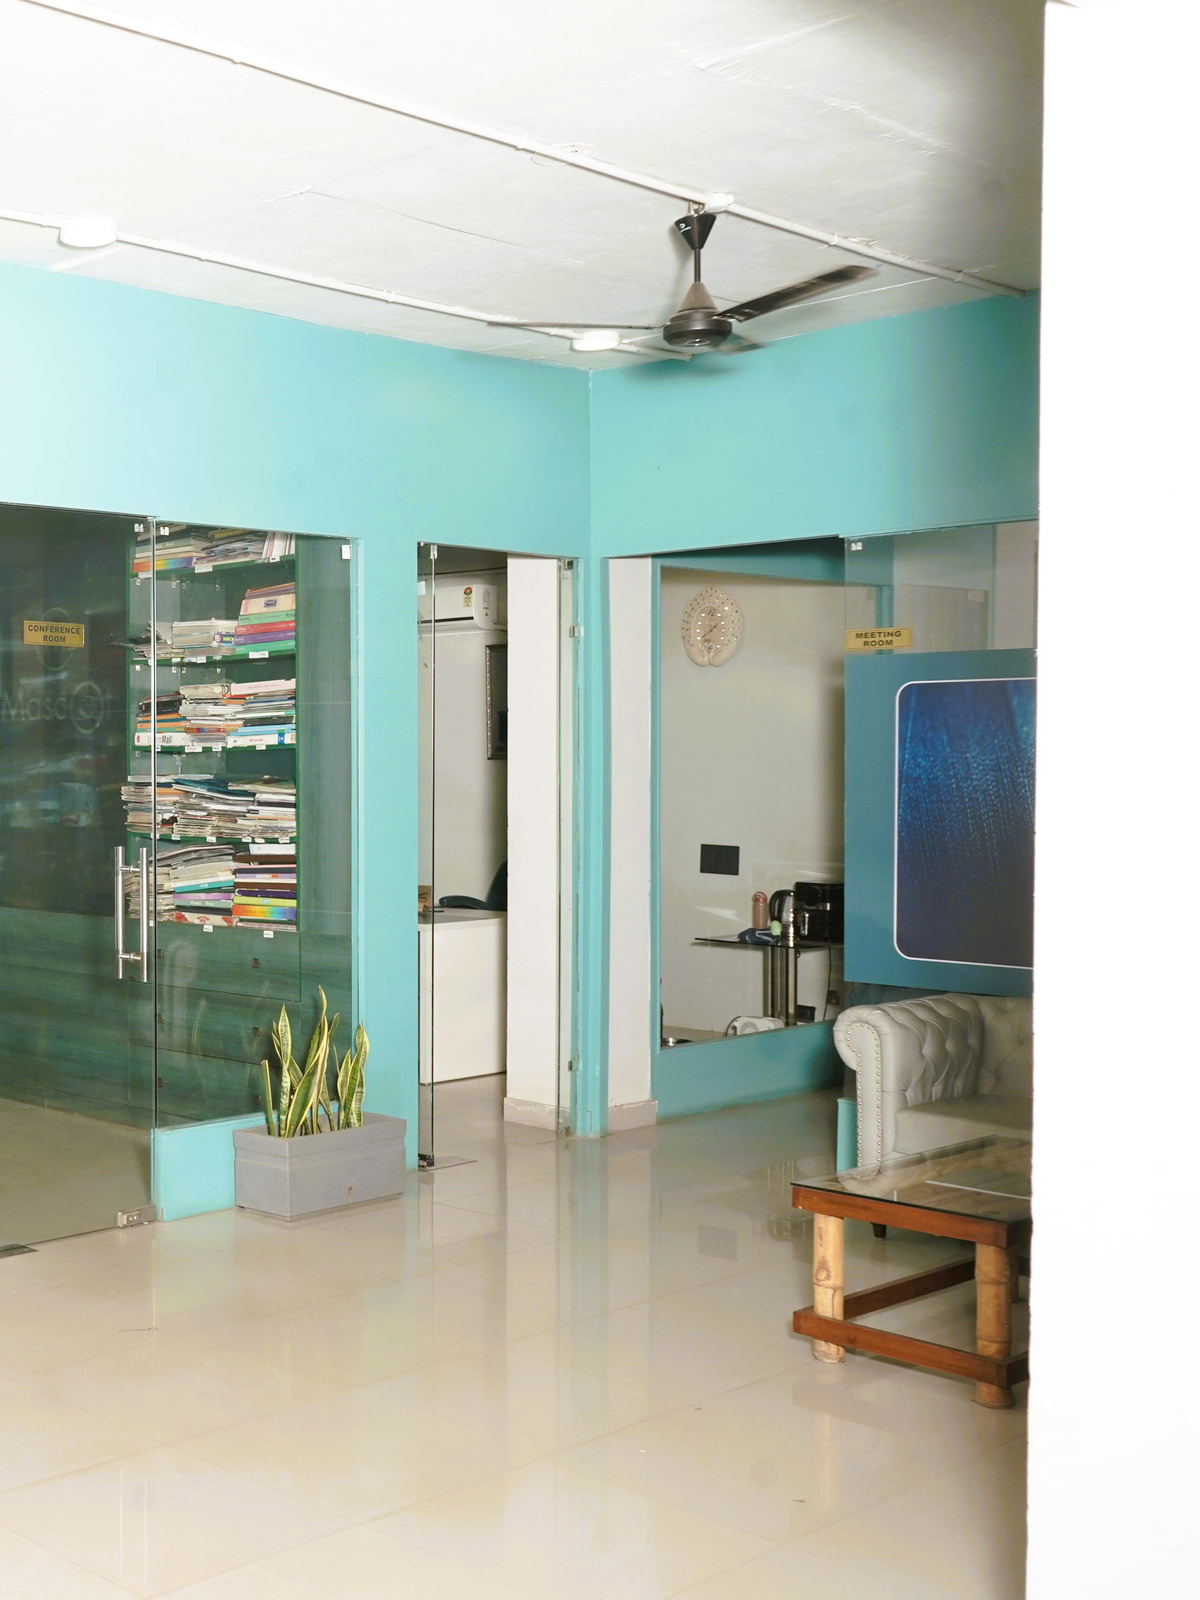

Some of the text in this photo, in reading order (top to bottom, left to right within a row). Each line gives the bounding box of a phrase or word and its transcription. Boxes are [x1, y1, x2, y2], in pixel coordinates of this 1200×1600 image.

[27, 624, 81, 635] CONFERENCE
[42, 634, 66, 643] ROOM
[855, 630, 902, 639] MEETING
[863, 639, 894, 647] ROOM
